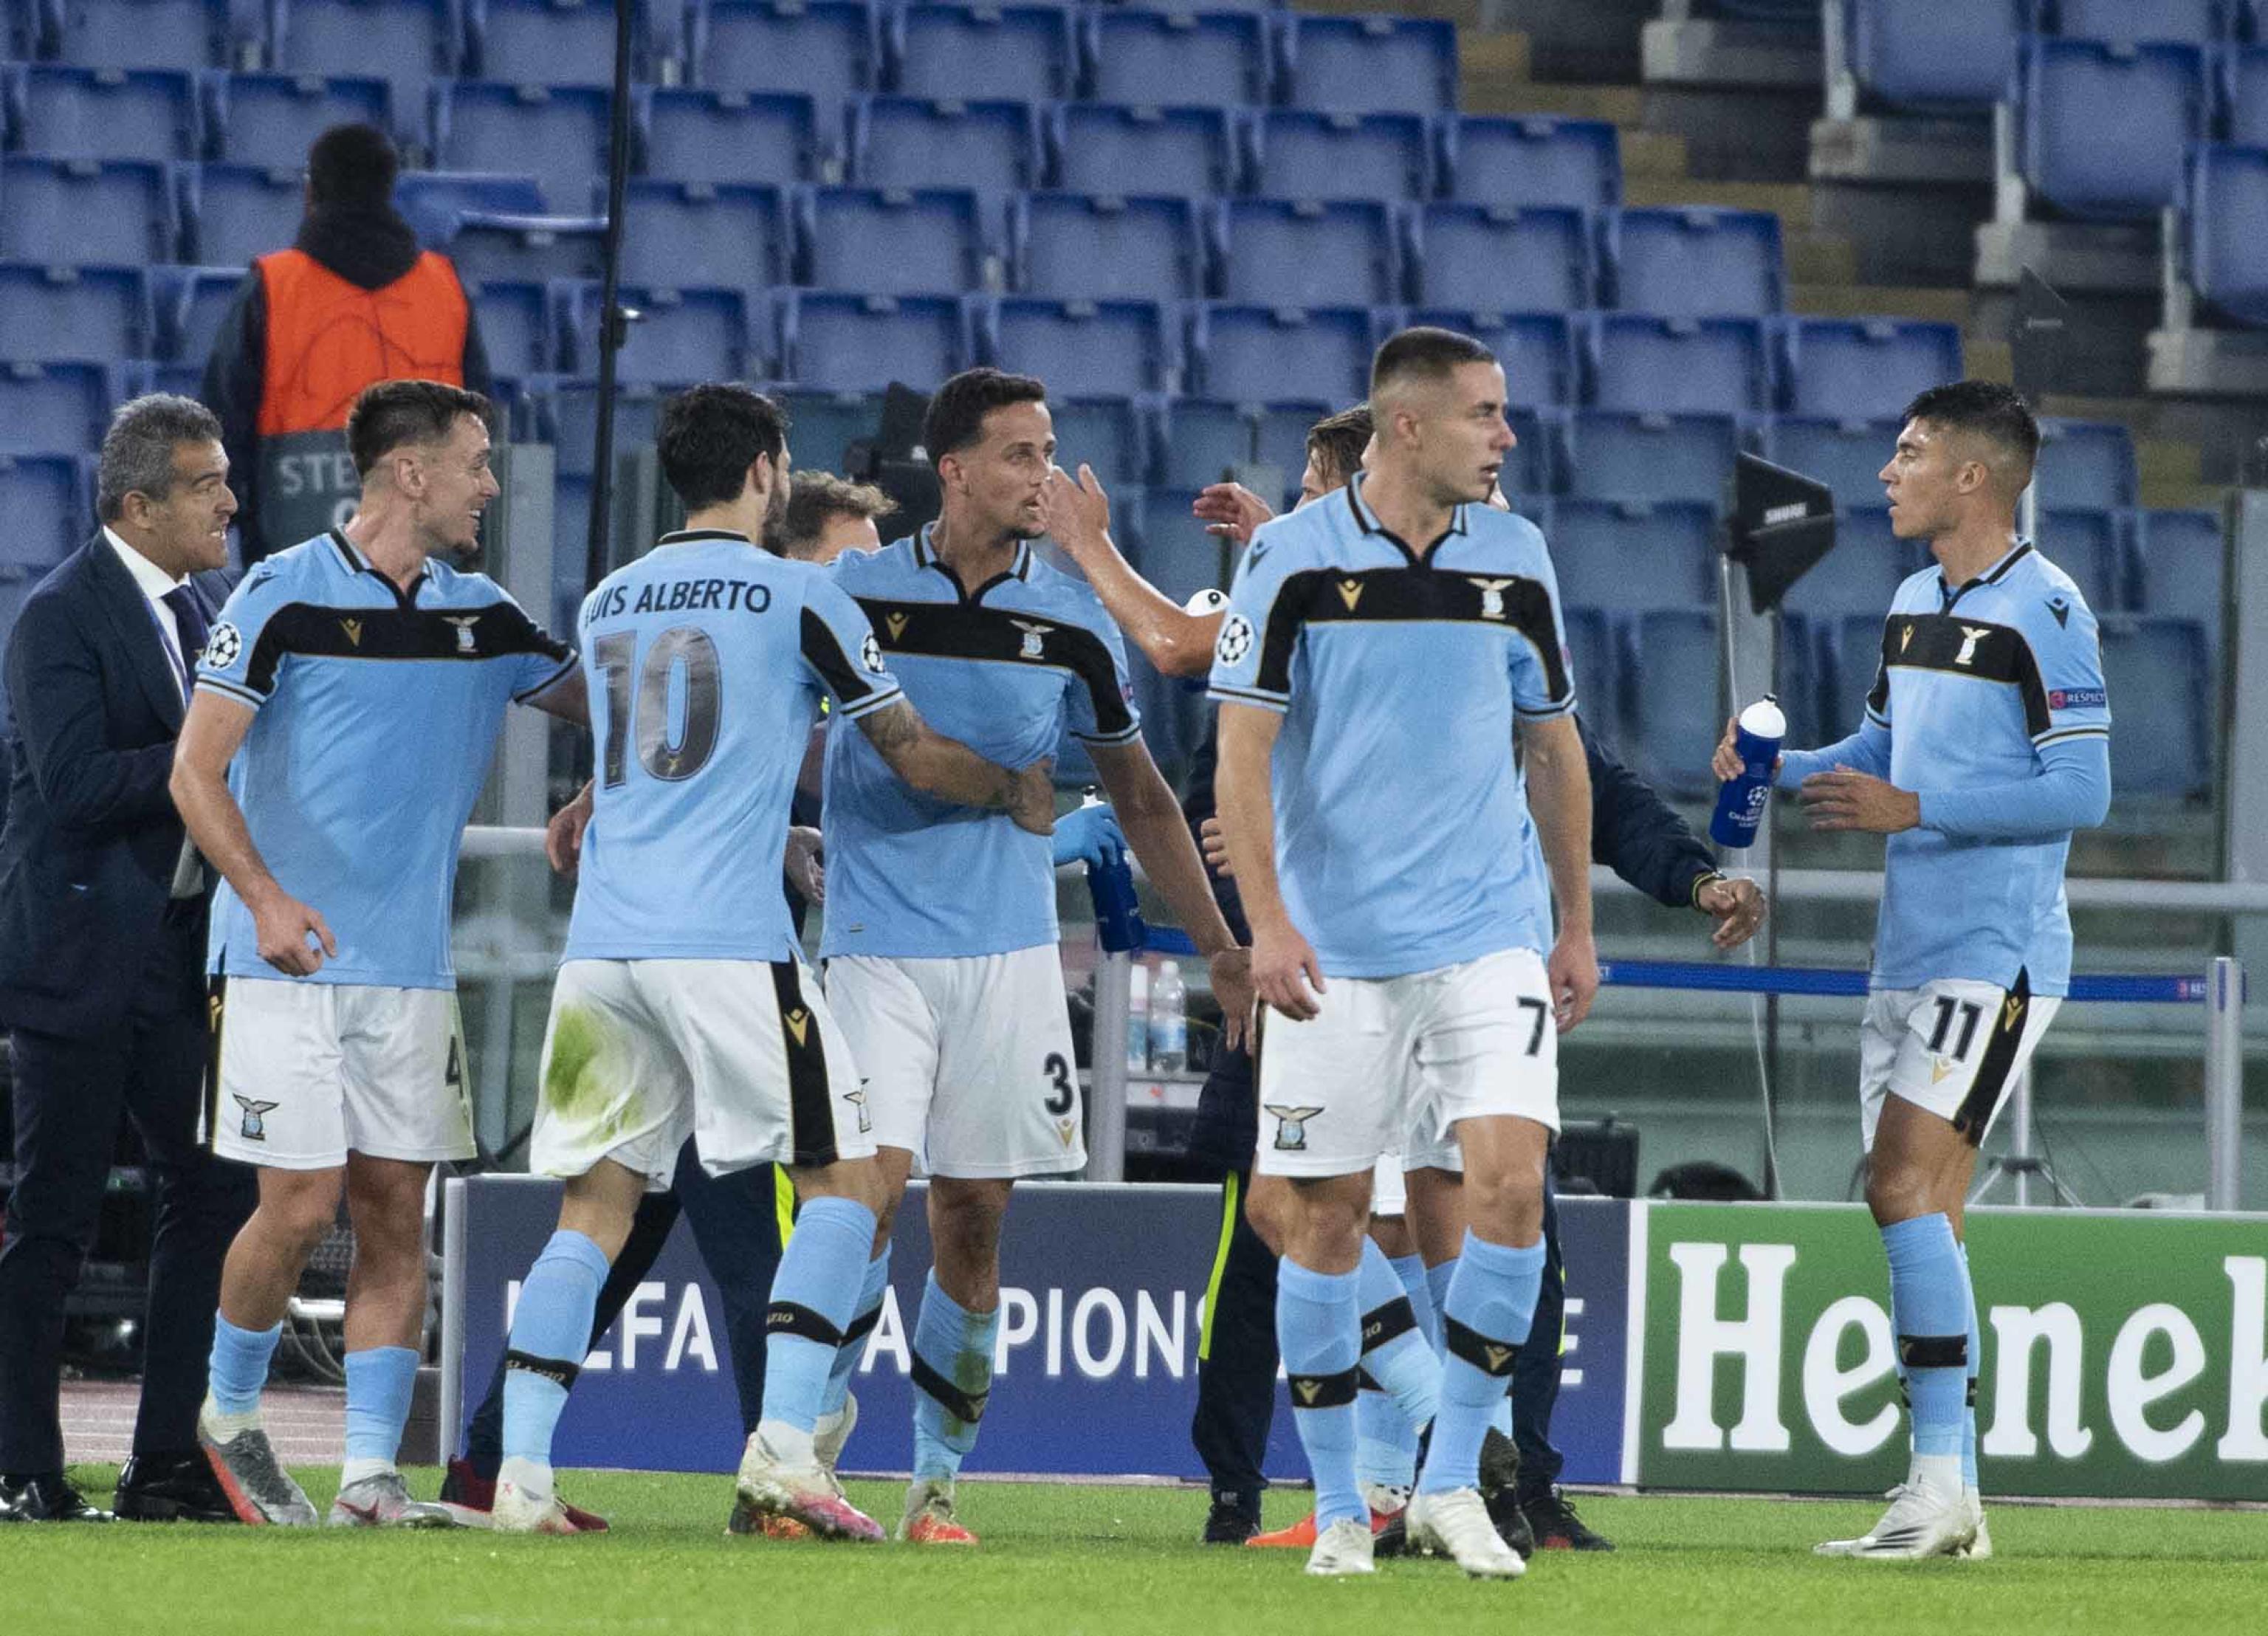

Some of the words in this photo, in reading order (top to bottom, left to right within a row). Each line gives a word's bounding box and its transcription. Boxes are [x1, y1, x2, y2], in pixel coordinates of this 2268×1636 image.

[634, 579, 772, 614] ALBERTO
[594, 626, 723, 790] 10
[1516, 994, 1548, 1057] 7
[1927, 995, 1984, 1062] 11
[444, 1034, 464, 1099] 4
[1043, 1051, 1073, 1116] 3
[507, 1279, 718, 1370] FA
[1663, 1242, 2268, 1463] Hene
